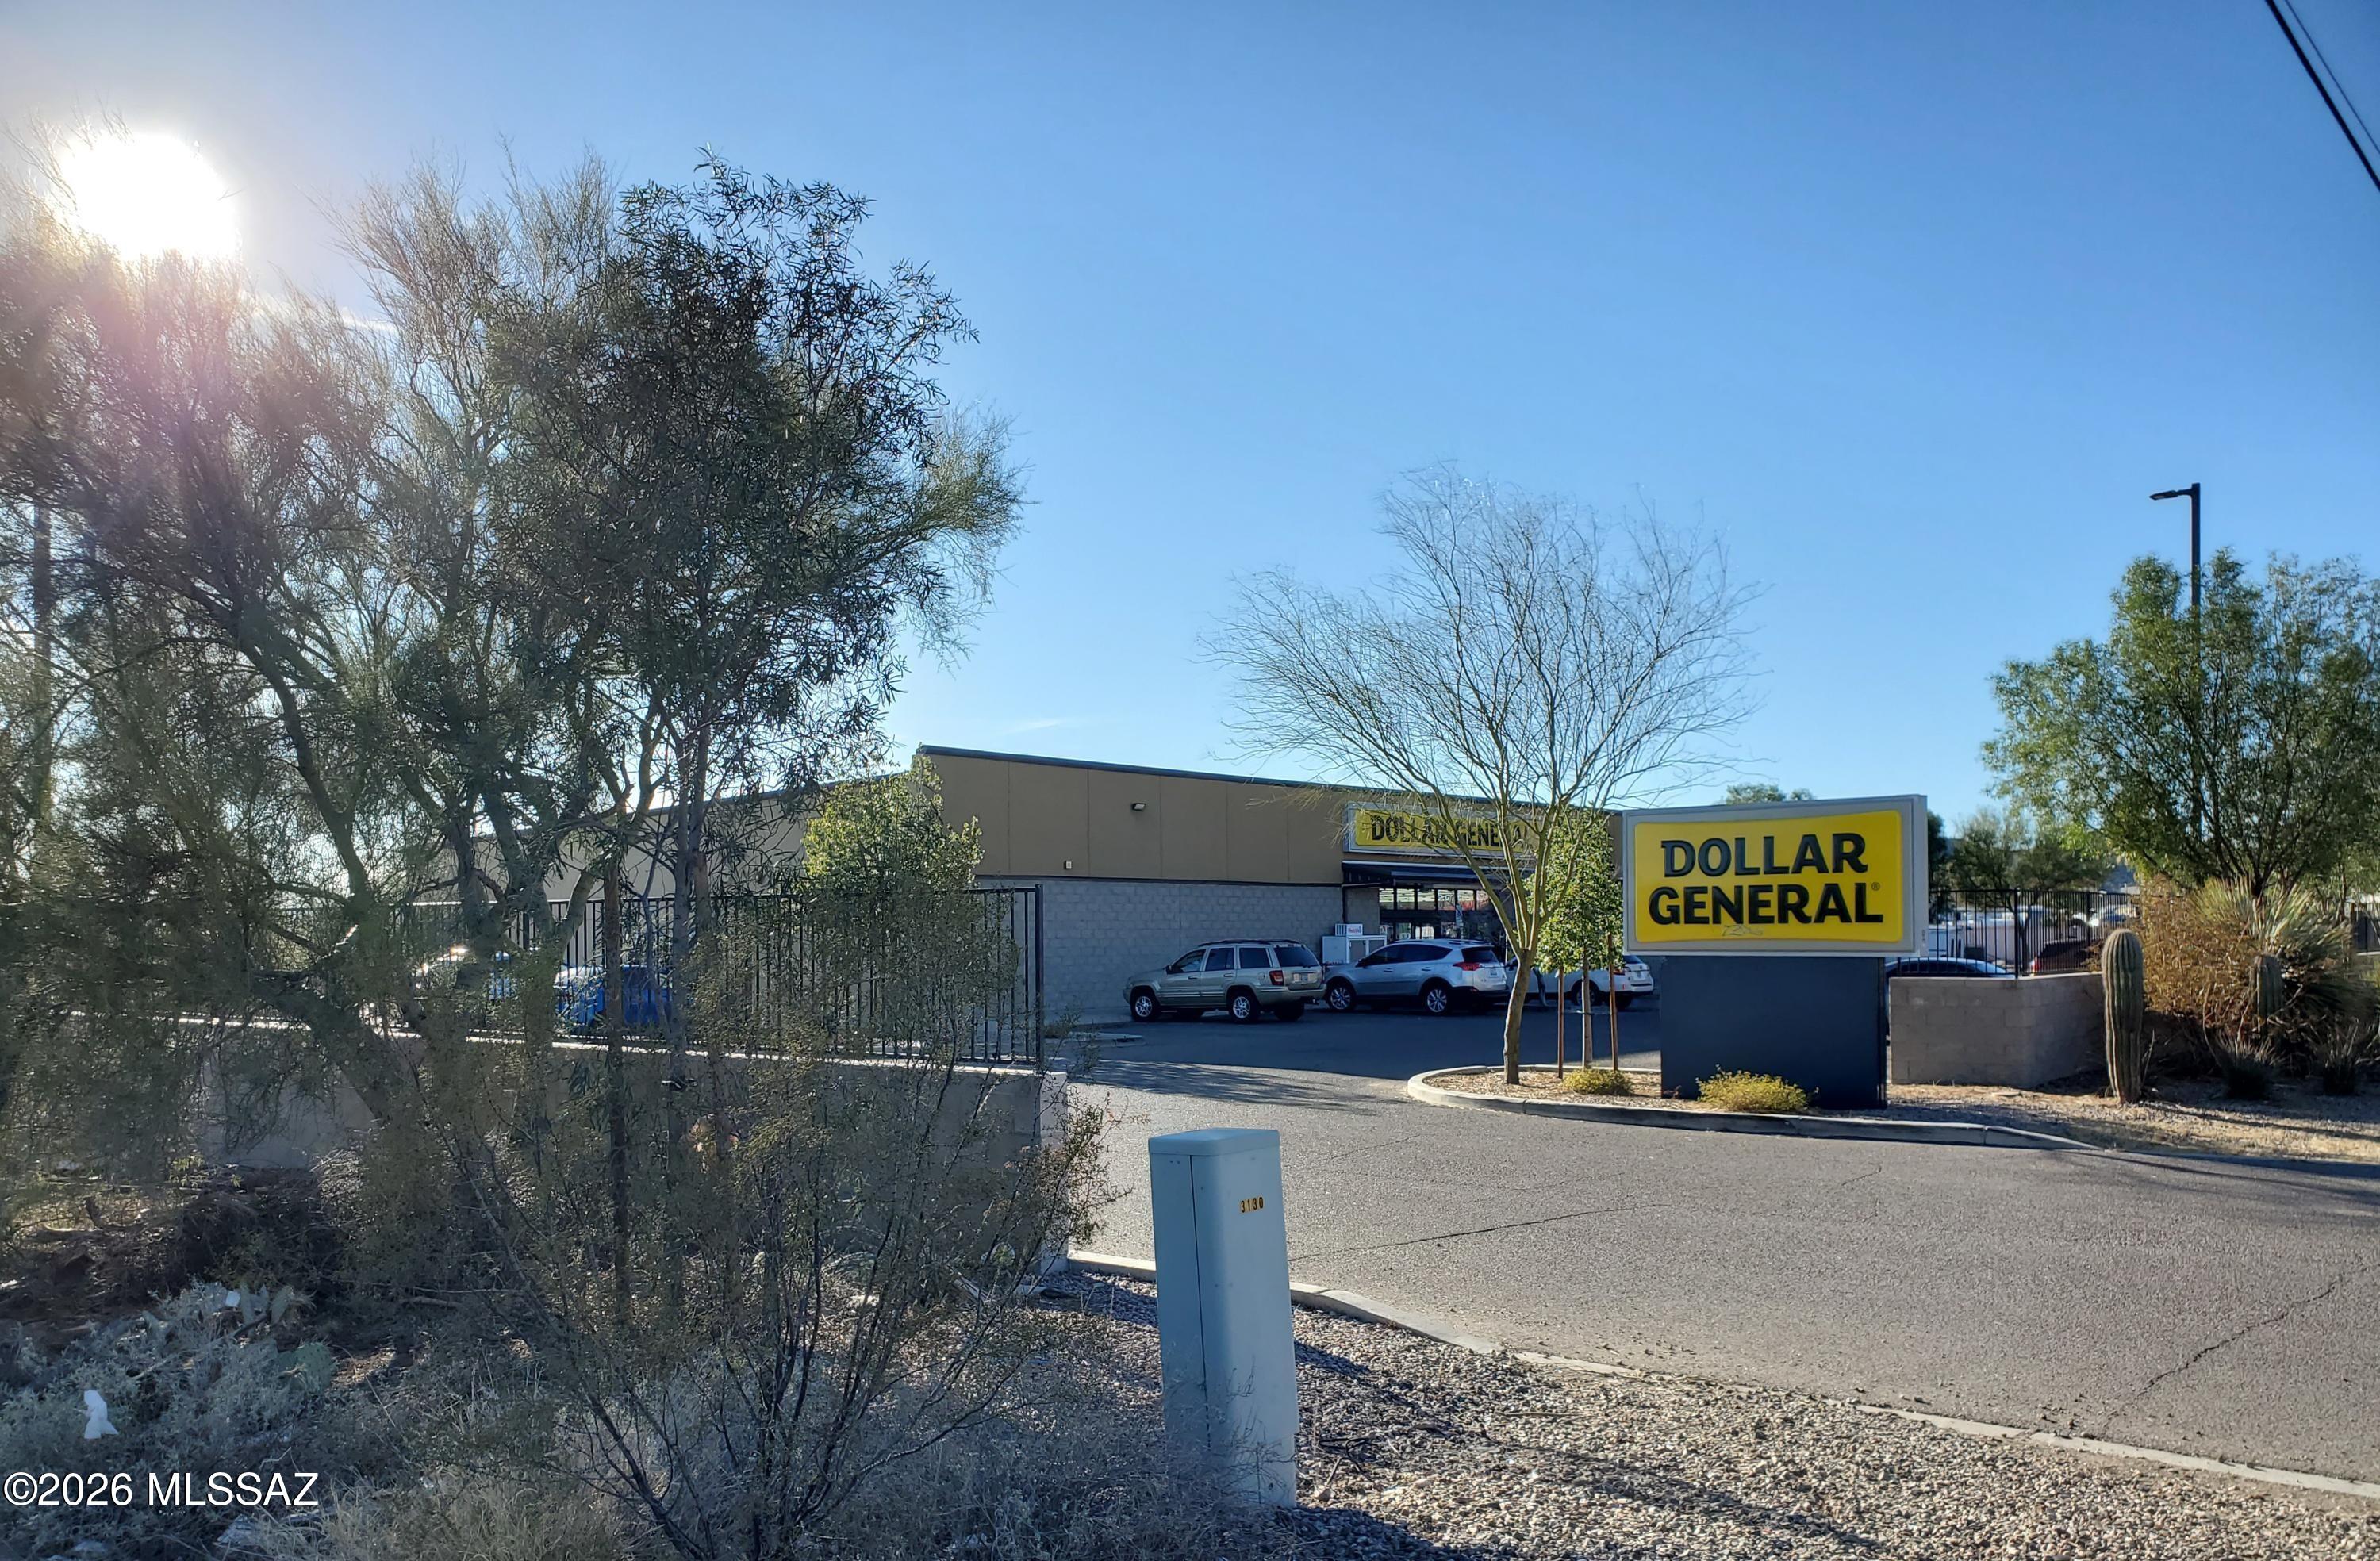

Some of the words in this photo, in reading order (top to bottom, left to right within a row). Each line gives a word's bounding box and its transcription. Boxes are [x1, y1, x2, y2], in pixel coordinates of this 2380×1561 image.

[1455, 820, 1533, 849] GENEA
[1660, 832, 1868, 877] DOLLAR
[1240, 1196, 1264, 1214] 3130
